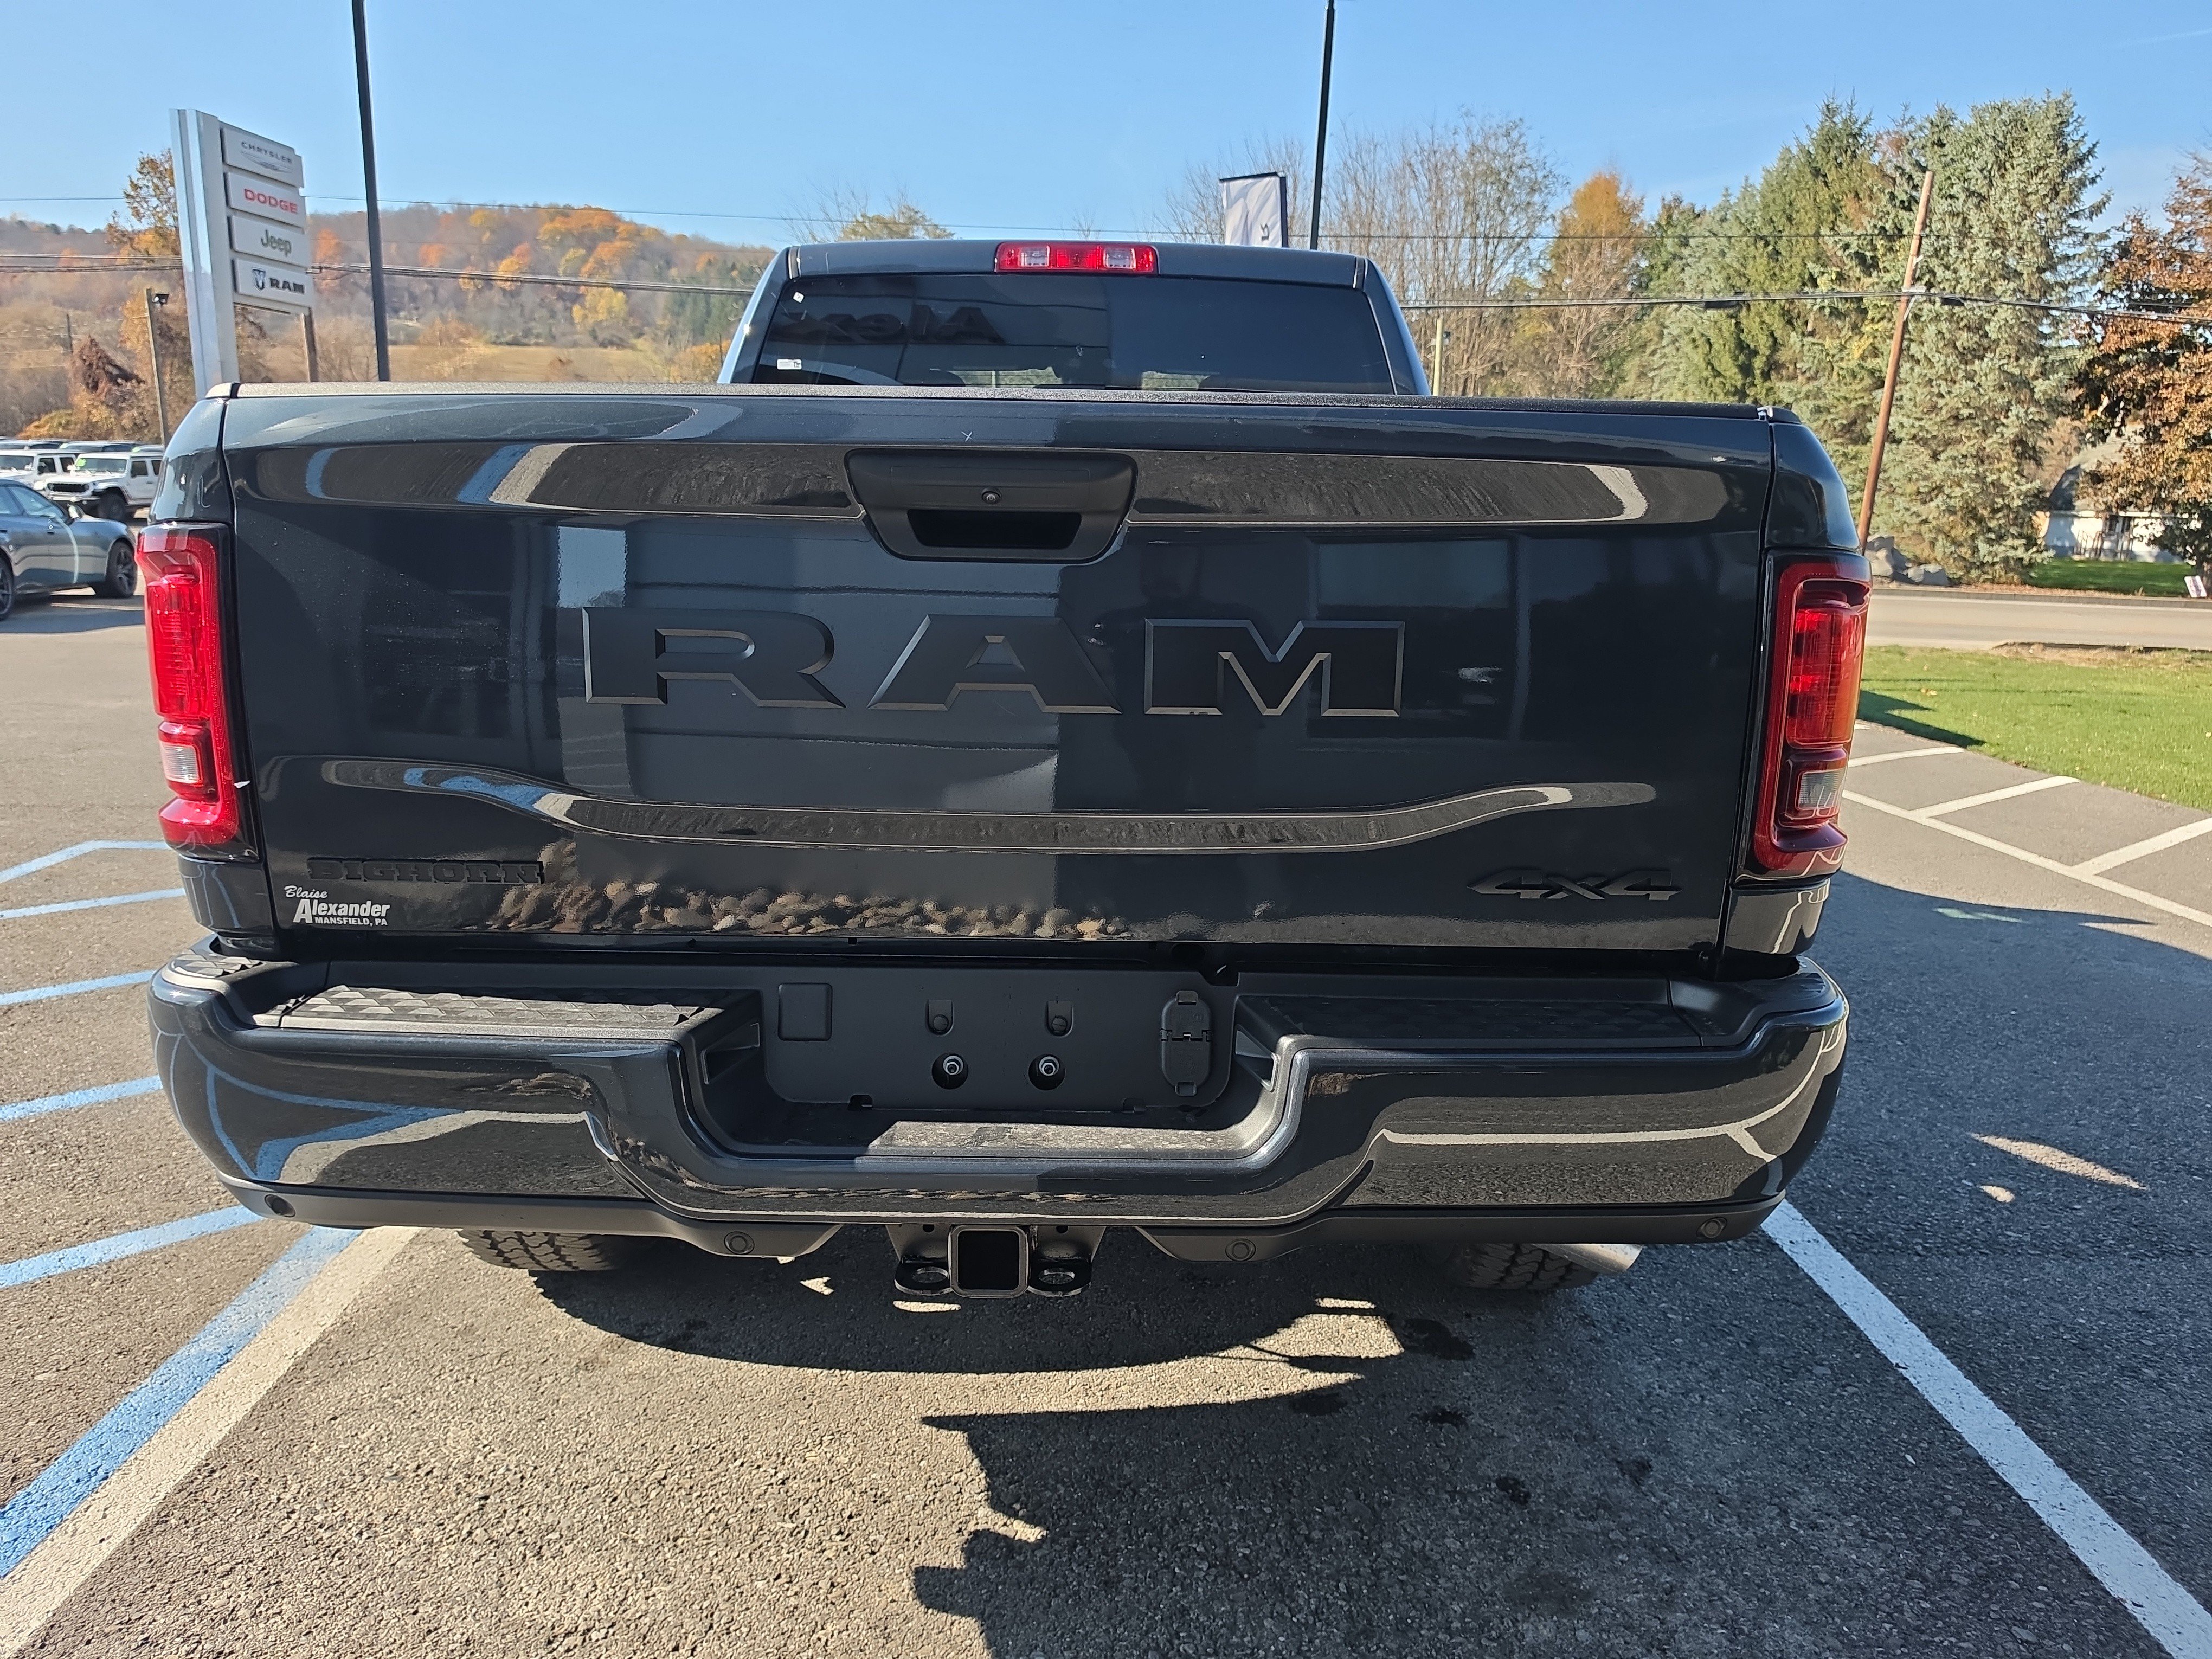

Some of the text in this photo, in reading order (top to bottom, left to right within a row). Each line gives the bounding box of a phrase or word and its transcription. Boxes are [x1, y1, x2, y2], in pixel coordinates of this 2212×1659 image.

[241, 142, 292, 163] CHRYSLER
[244, 188, 298, 214] DODGE
[260, 229, 292, 257] Jeep
[269, 277, 305, 295] RAM
[582, 607, 1405, 718] RAM
[284, 885, 328, 899] Blaise
[292, 898, 390, 923] Alexander
[314, 916, 388, 927] MANSFIELD, PA
